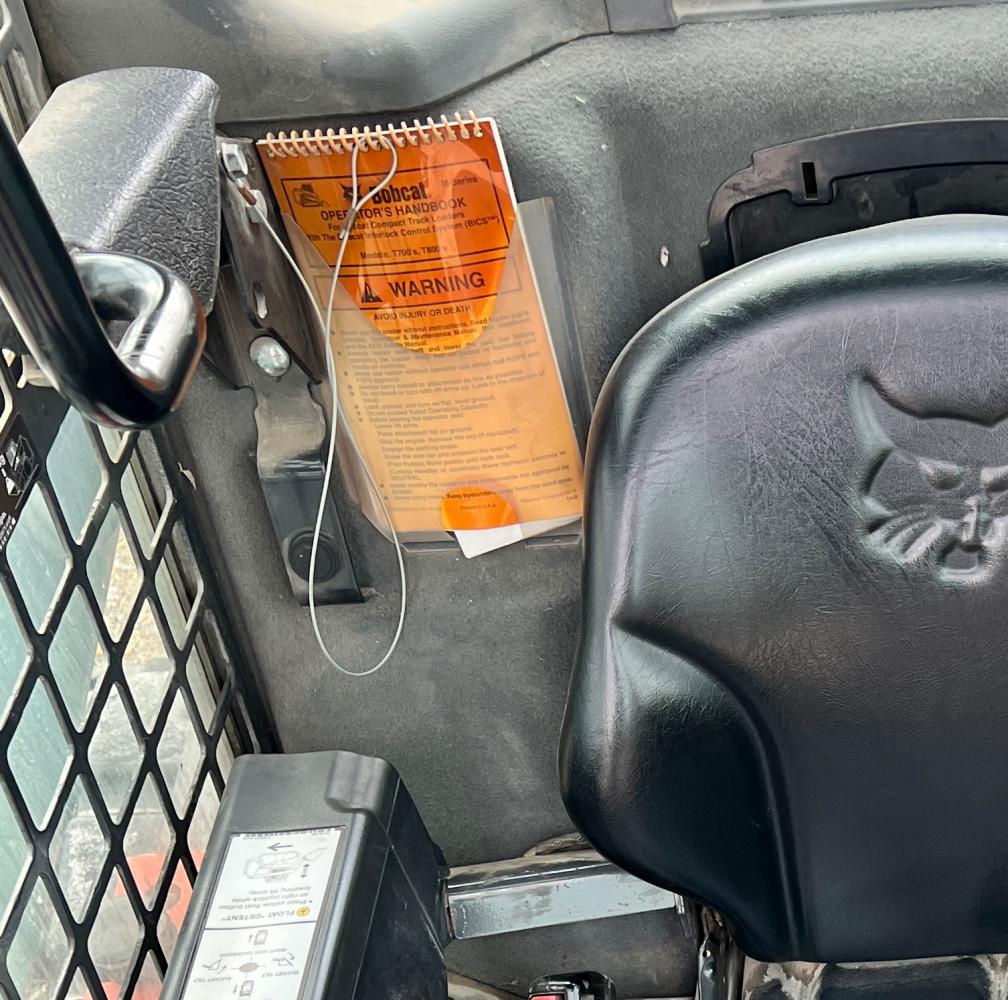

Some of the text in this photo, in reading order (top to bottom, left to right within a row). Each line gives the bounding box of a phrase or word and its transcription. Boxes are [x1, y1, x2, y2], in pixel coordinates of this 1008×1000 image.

[394, 197, 466, 215] HANDBOOK
[386, 271, 486, 298] WARNING
[372, 304, 471, 321] AVOID INJURY OR DEATH
